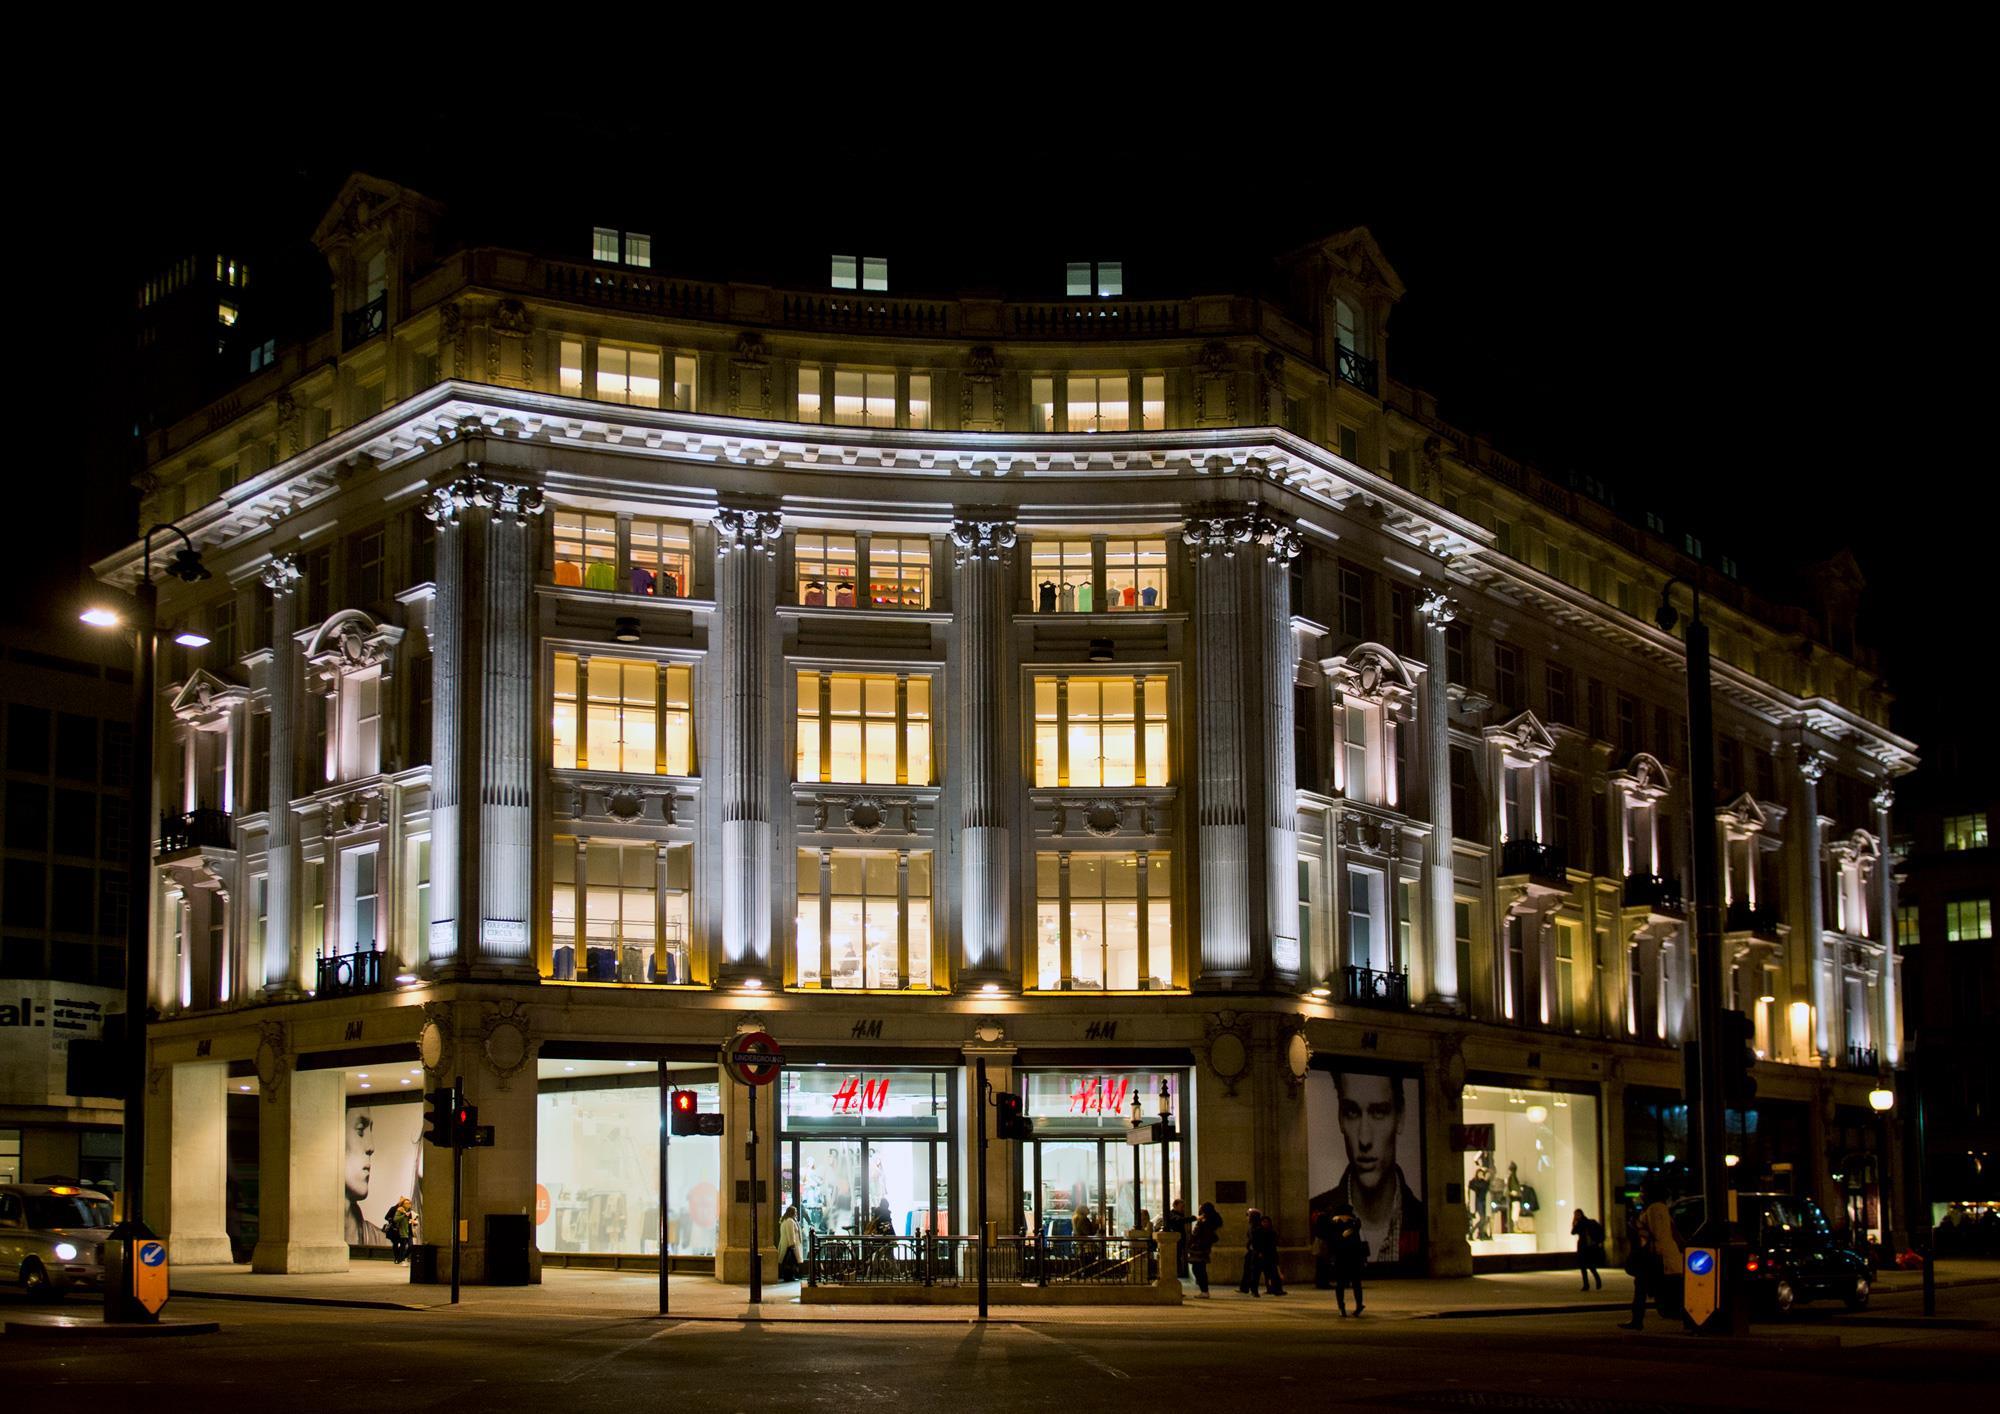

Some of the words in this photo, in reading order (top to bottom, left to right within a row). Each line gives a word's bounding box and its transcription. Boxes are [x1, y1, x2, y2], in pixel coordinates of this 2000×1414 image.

[734, 1053, 785, 1064] UNDERGROUND
[831, 1078, 890, 1113] H&M
[1070, 1078, 1128, 1114] H&M
